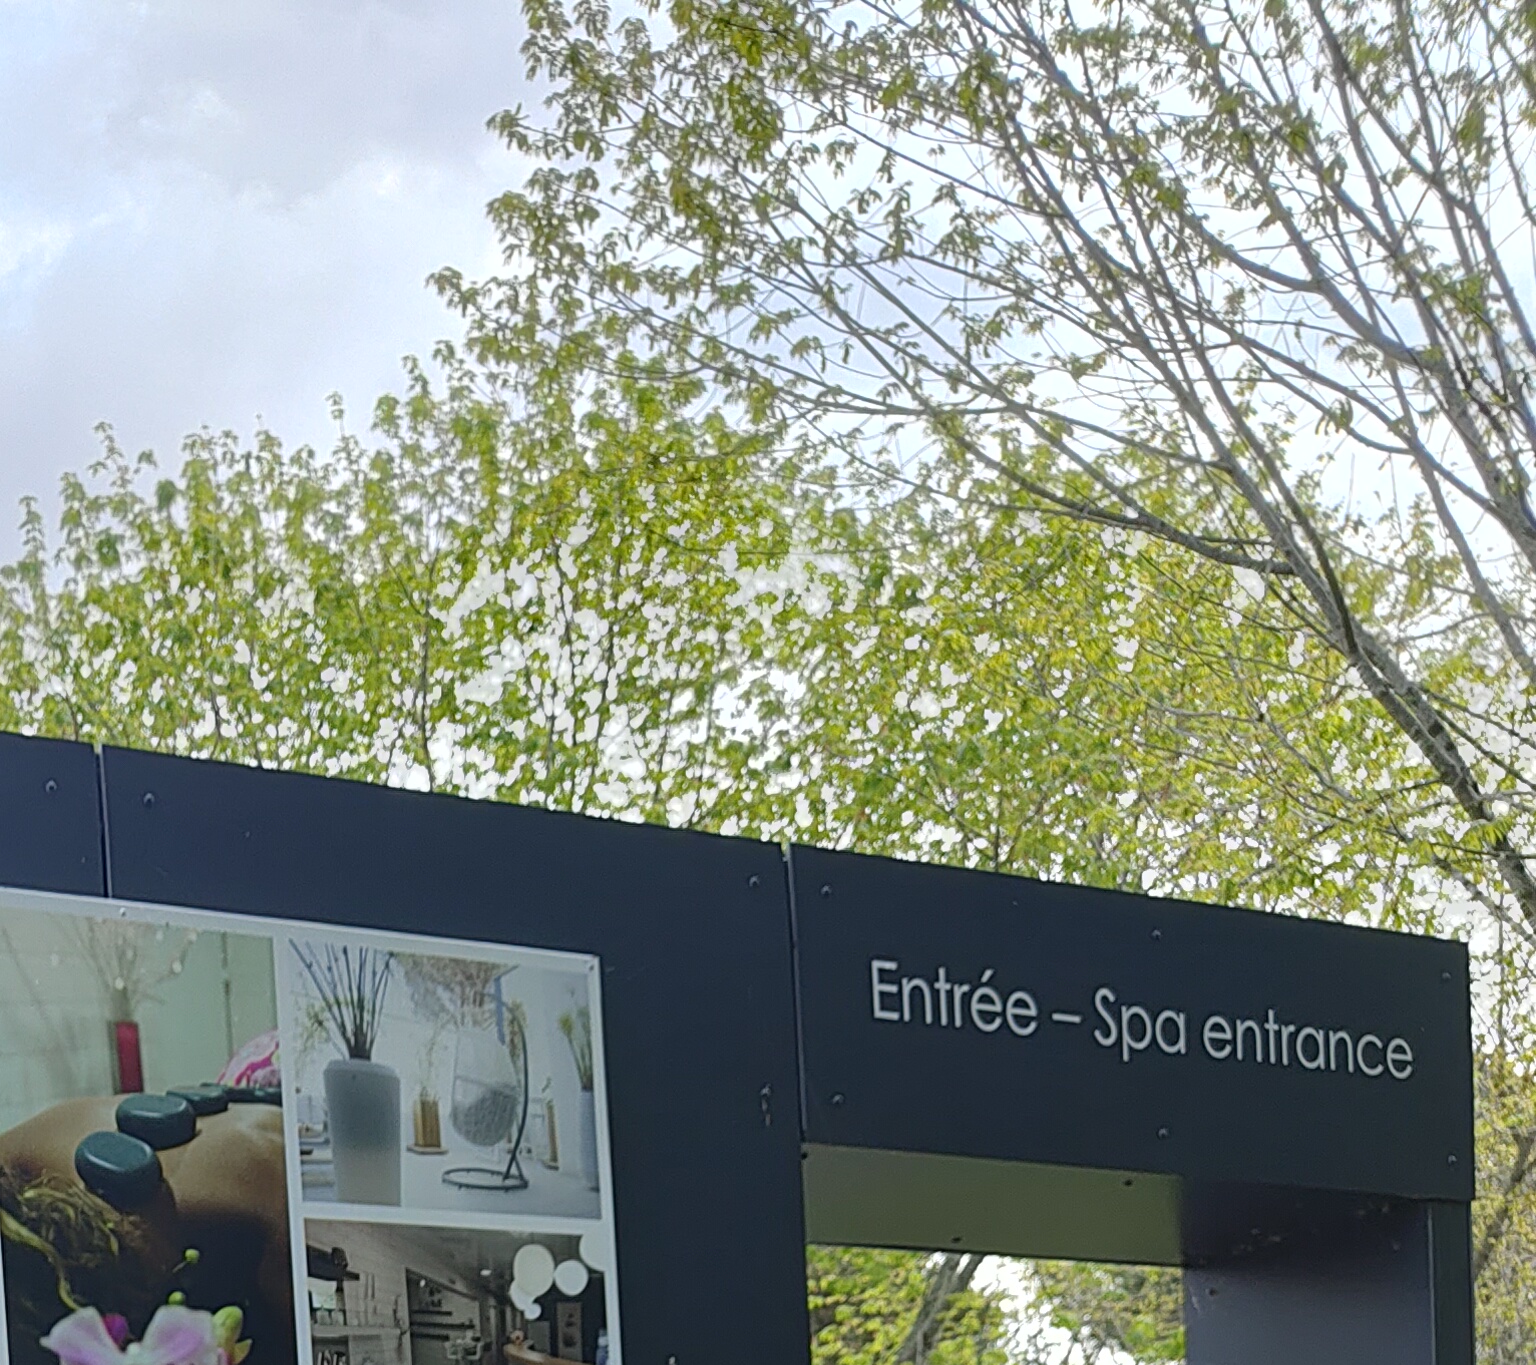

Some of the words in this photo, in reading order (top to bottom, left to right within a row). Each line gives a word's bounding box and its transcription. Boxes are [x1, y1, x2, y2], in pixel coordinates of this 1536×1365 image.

[871, 959, 1038, 1036] Entrée
[1094, 988, 1186, 1062] Spa
[1203, 1009, 1413, 1079] entrance
